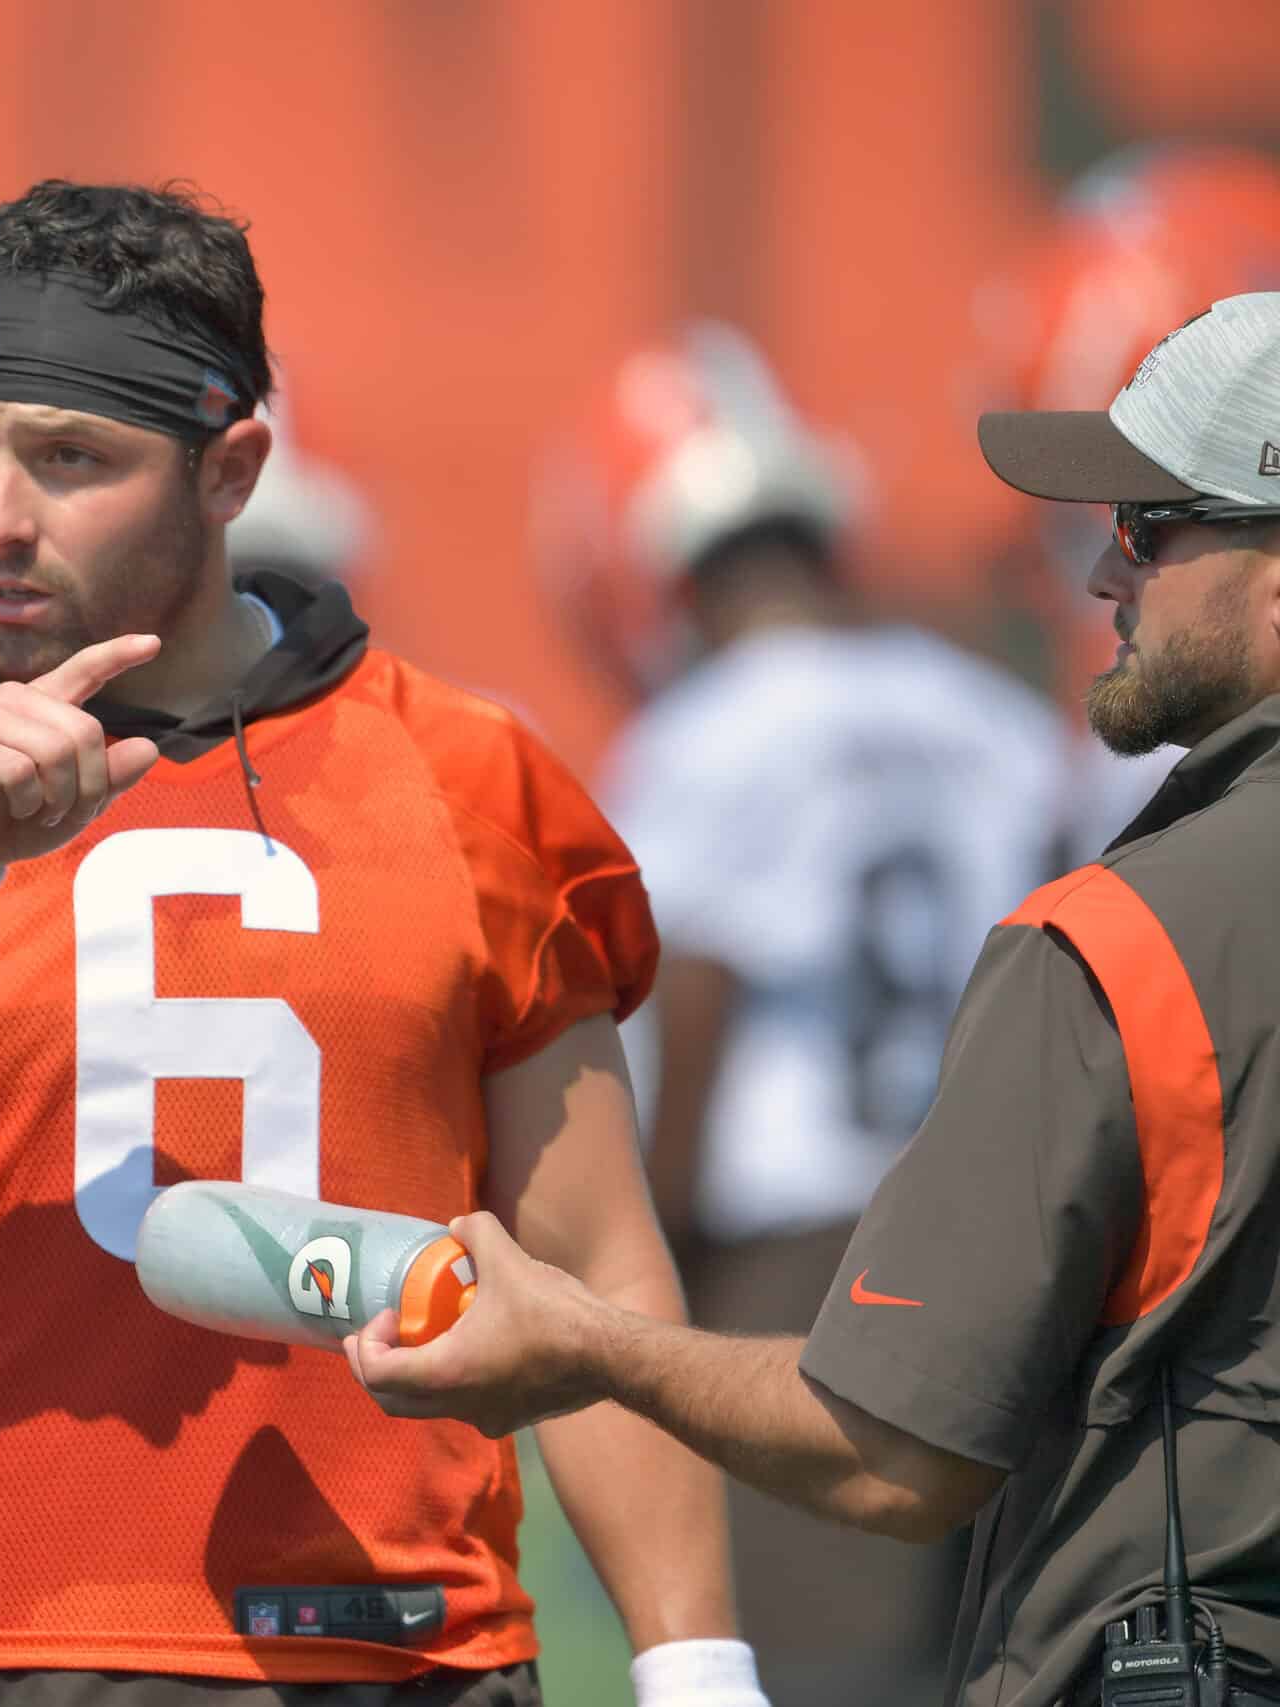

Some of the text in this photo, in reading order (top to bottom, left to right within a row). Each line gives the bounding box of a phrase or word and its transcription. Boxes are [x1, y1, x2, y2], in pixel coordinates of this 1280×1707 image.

[73, 827, 322, 1264] 6
[288, 1235, 352, 1320] G
[1126, 1657, 1179, 1668] MOTOROLA
